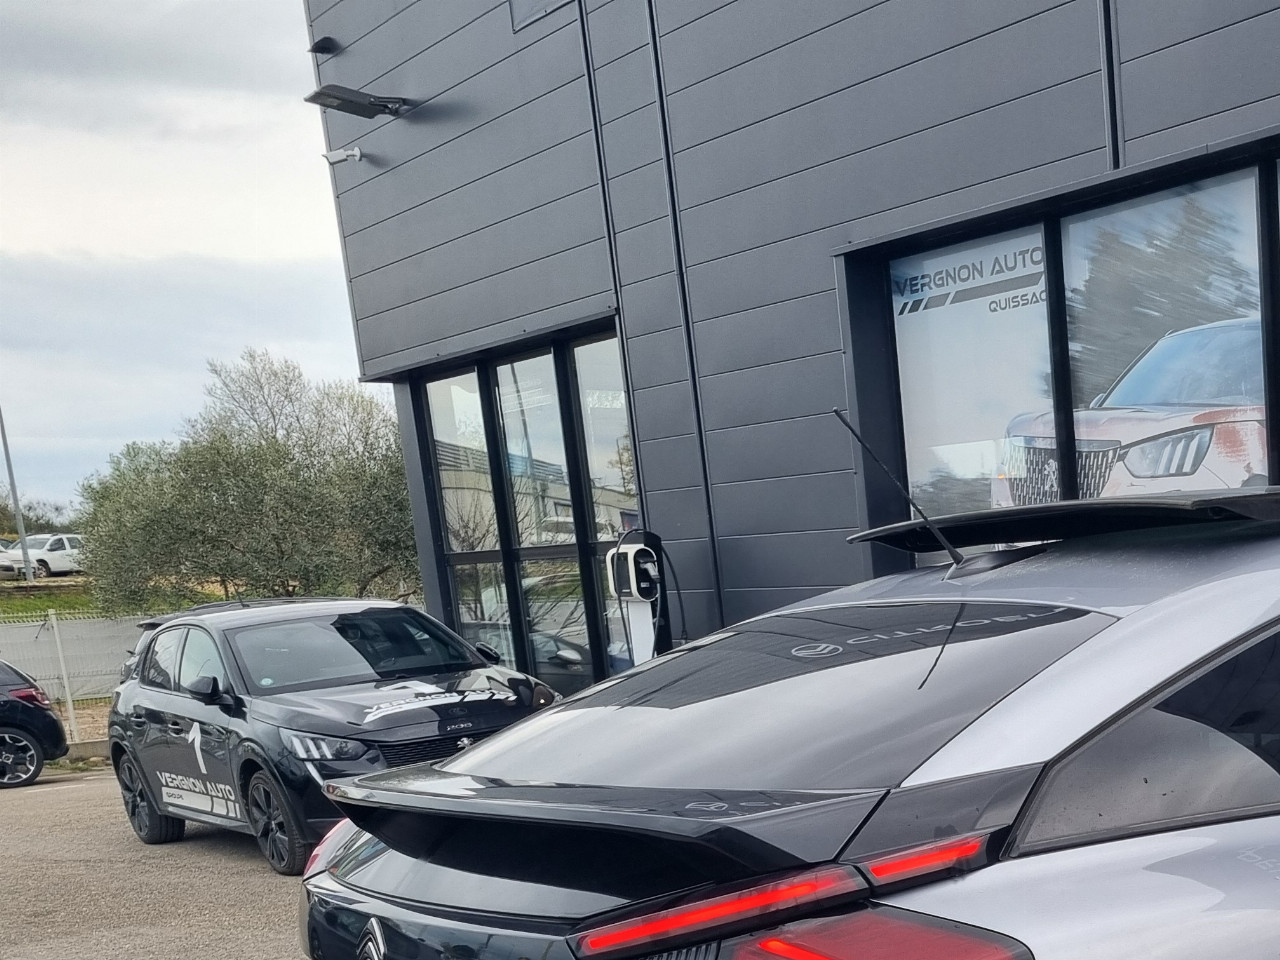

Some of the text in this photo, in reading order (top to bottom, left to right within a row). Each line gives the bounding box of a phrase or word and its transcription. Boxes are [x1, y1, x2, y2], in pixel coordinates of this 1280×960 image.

[895, 246, 1045, 297] VERGNON AUTO
[156, 770, 236, 801] VERGNON AUTO
